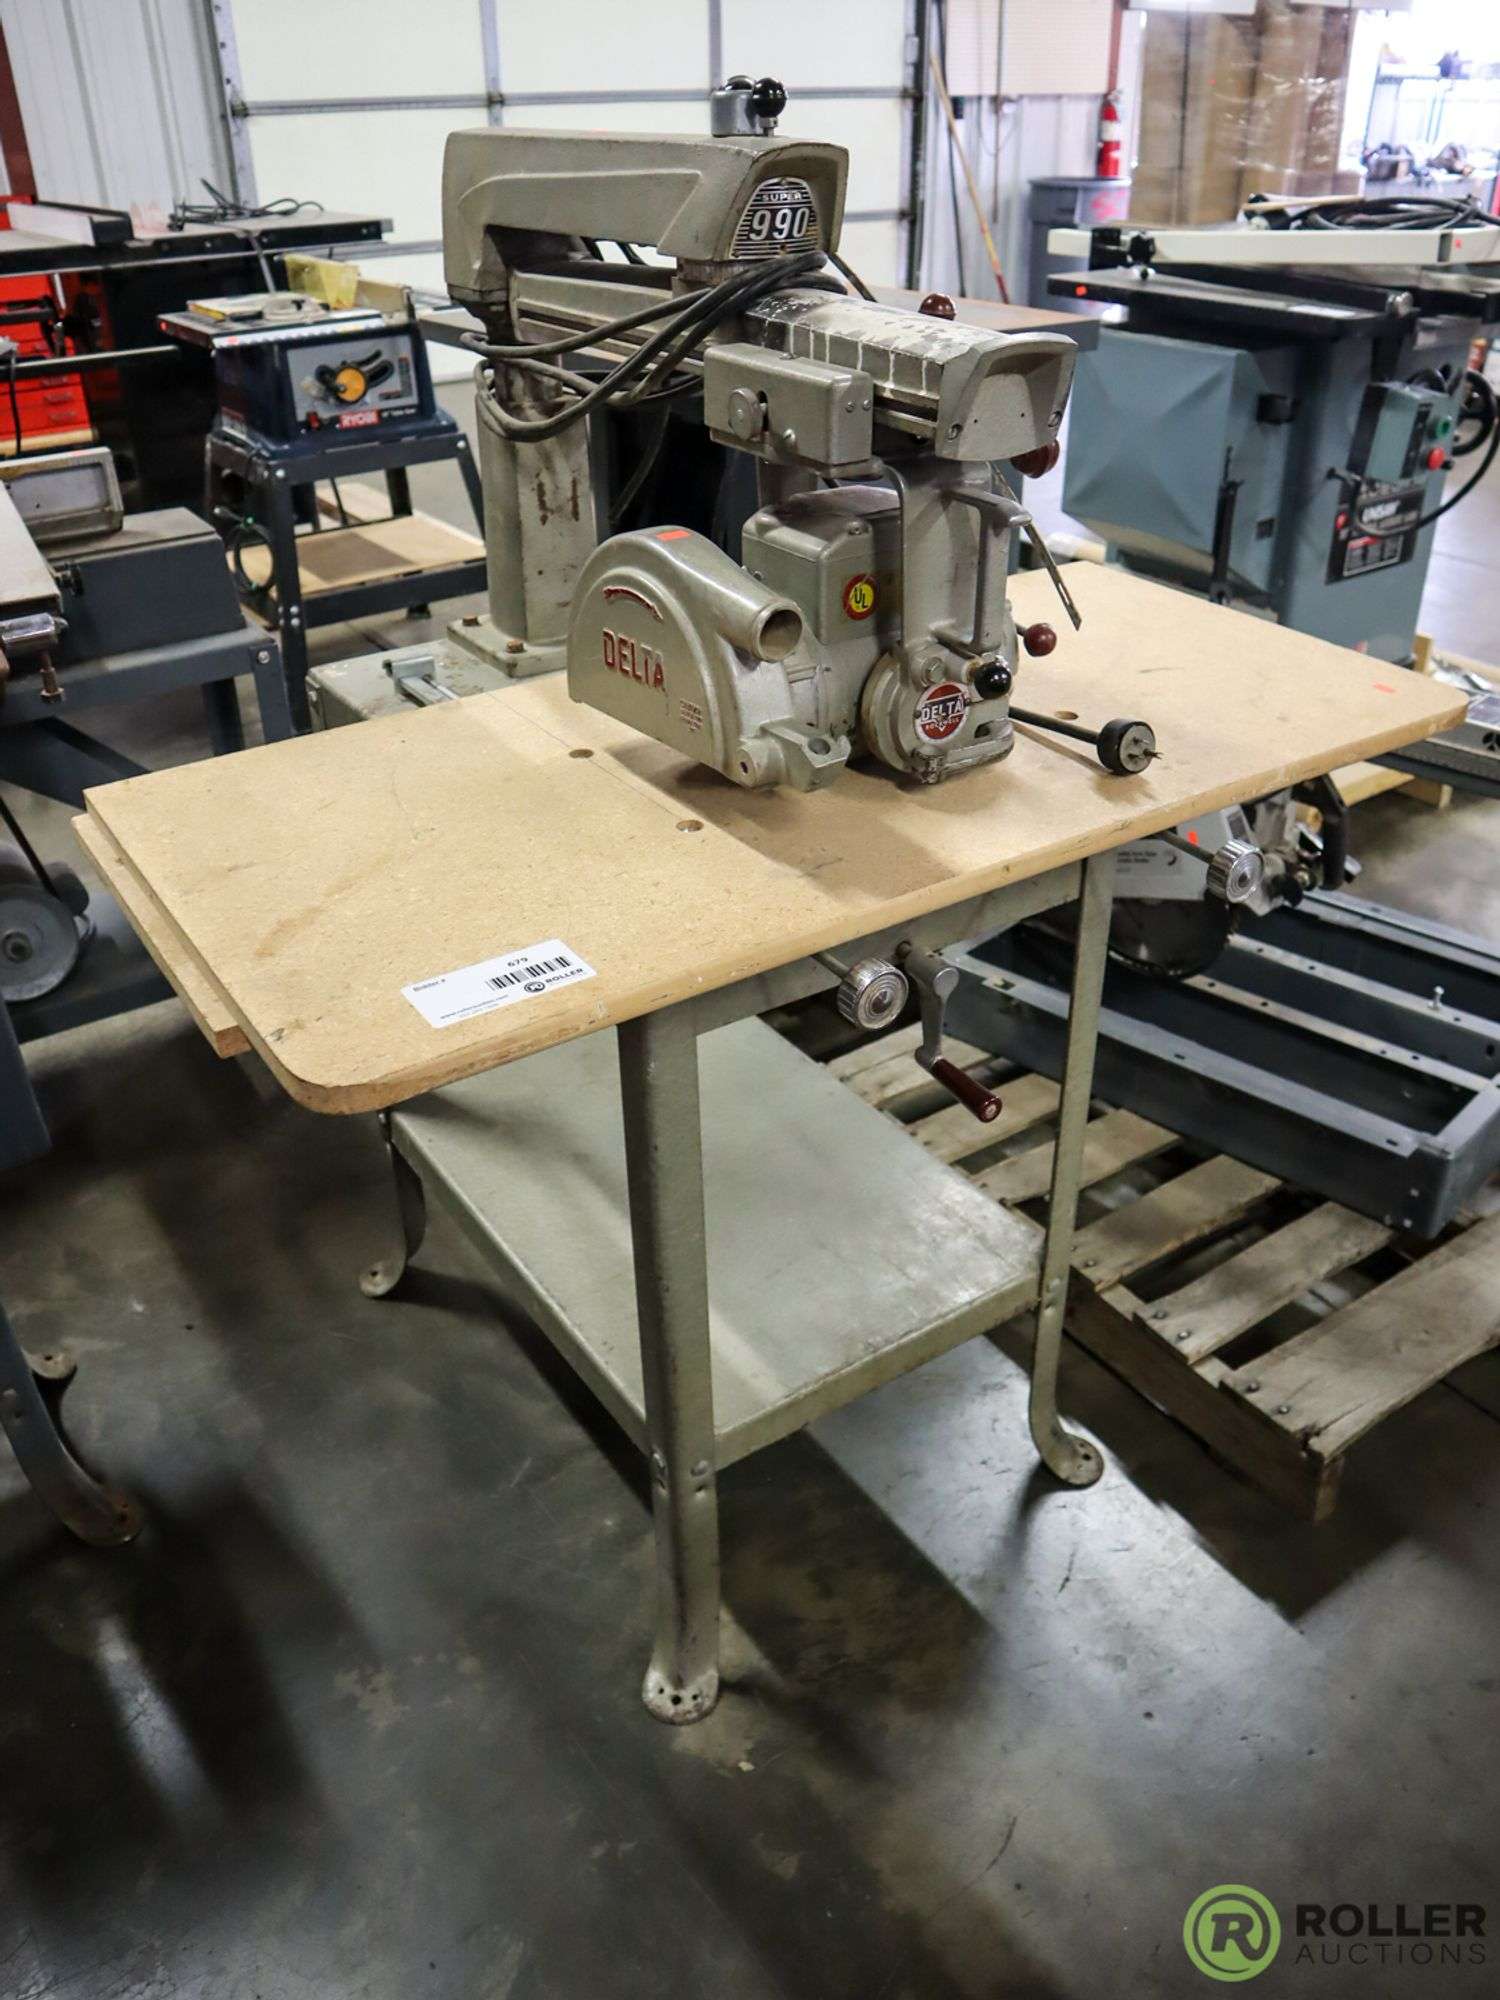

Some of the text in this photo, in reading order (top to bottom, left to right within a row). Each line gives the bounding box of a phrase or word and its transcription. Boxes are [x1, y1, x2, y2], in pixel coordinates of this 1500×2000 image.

[762, 191, 802, 201] SUPER
[749, 207, 810, 240] 990
[339, 410, 379, 428] RYOBI
[602, 627, 667, 690] DELTA
[921, 695, 965, 722] DELTA
[507, 957, 529, 968] 679
[545, 968, 585, 984] ROLLER
